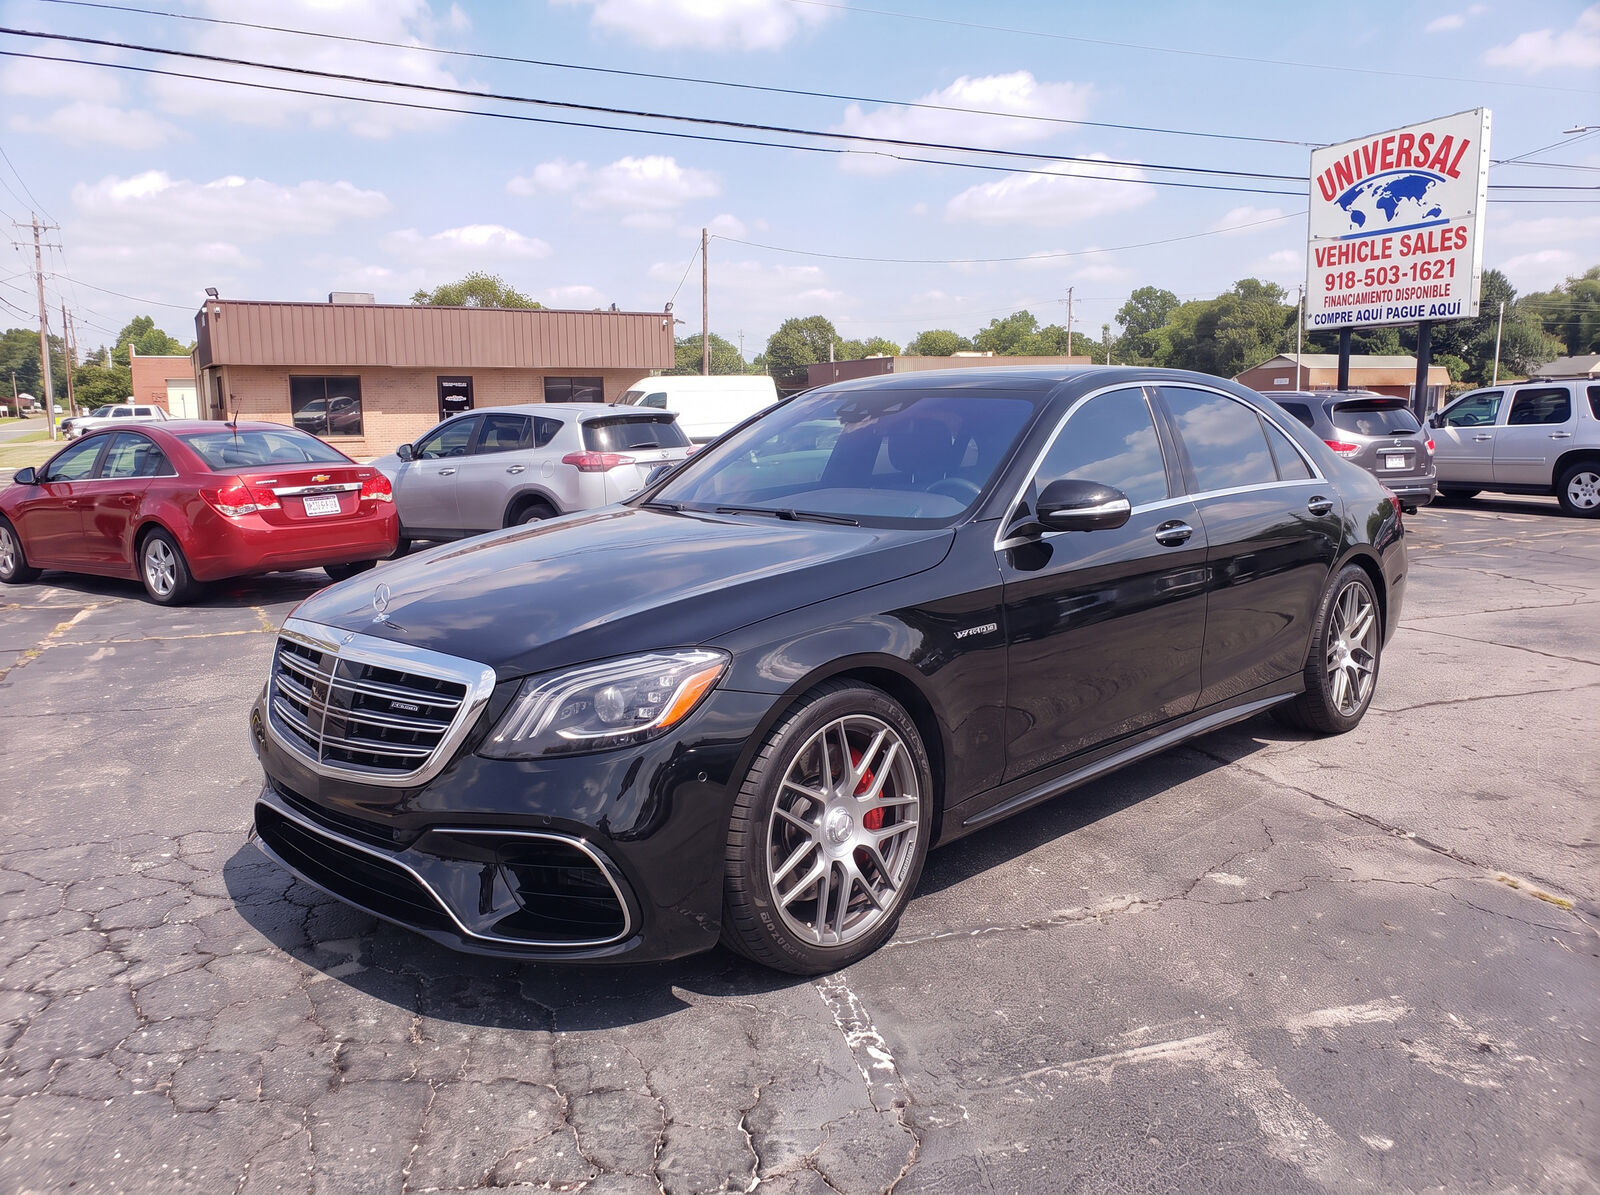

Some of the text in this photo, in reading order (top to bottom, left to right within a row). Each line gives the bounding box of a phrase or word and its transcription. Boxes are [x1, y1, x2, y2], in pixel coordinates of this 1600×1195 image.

[1316, 133, 1470, 202] UNIVERSAL
[1315, 226, 1467, 268] VEHICLE SALES
[1325, 258, 1455, 291] 918-503-1621
[1314, 311, 1353, 325] COMPRE
[1386, 304, 1425, 319] PAGUE
[1429, 299, 1462, 316] AQUÍ
[1324, 283, 1451, 308] FINANCIAMIENTO DISPONIBLE
